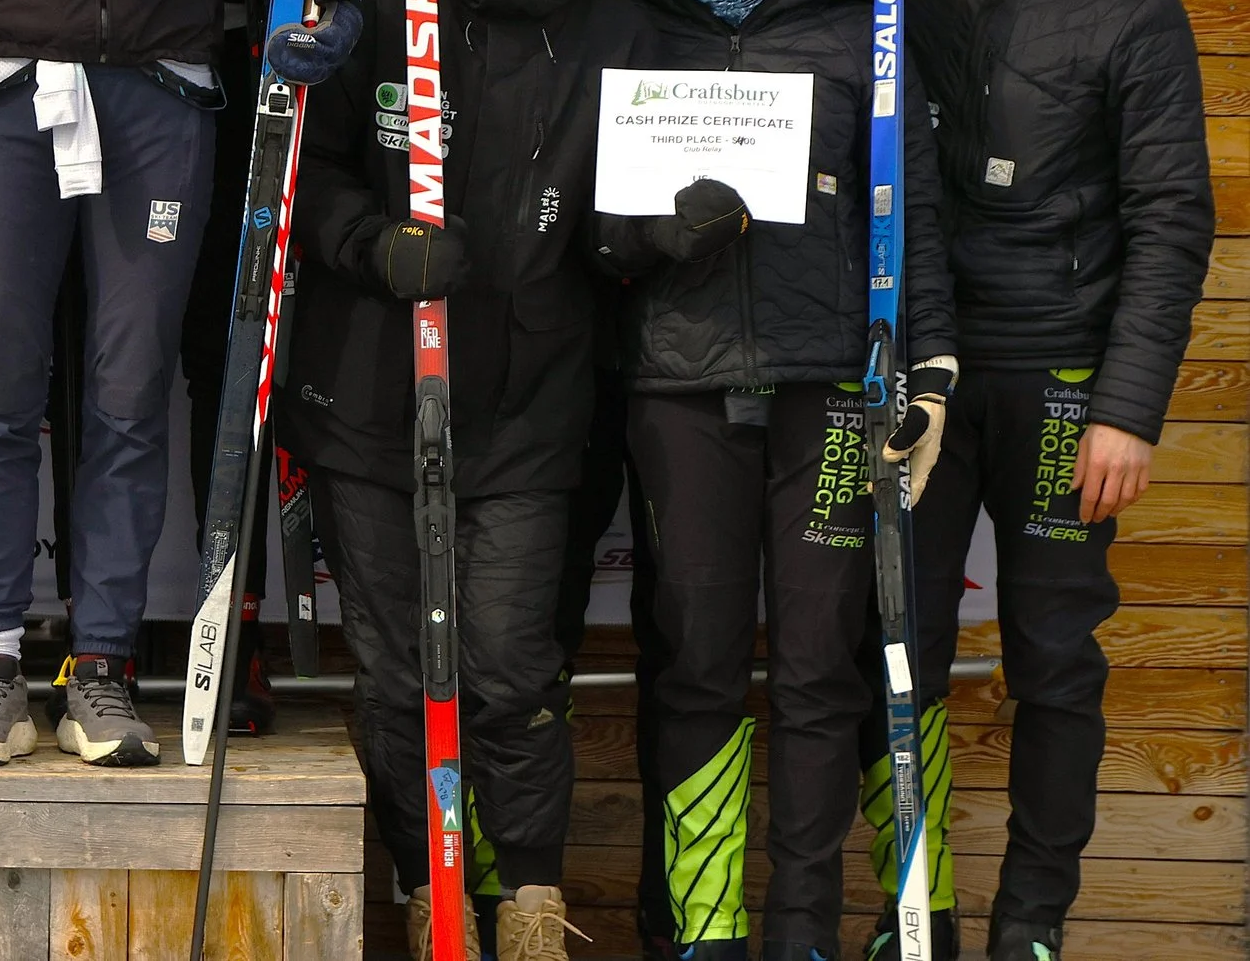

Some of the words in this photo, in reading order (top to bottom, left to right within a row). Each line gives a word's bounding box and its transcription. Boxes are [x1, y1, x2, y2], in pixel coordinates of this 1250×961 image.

[286, 42, 317, 50] DIGGINS
[671, 82, 780, 107] Craftsbury
[615, 115, 654, 126] CASH
[658, 115, 699, 126] PRIZE
[702, 116, 794, 130] CERTIFICATE
[650, 135, 683, 145] THIRD
[686, 135, 722, 145] PLACE
[701, 146, 722, 154] Relay
[152, 202, 179, 215] US
[420, 327, 438, 339] RED
[420, 337, 442, 349] LINE
[1044, 387, 1090, 400] Craftsbu
[1032, 402, 1062, 512] PROJECT
[1054, 402, 1081, 496] RACING
[812, 410, 845, 520] PROJECT
[835, 413, 865, 505] RACING
[801, 529, 866, 549] SkiERG
[1023, 522, 1089, 542] SkiERG
[443, 833, 455, 868] REDLINE
